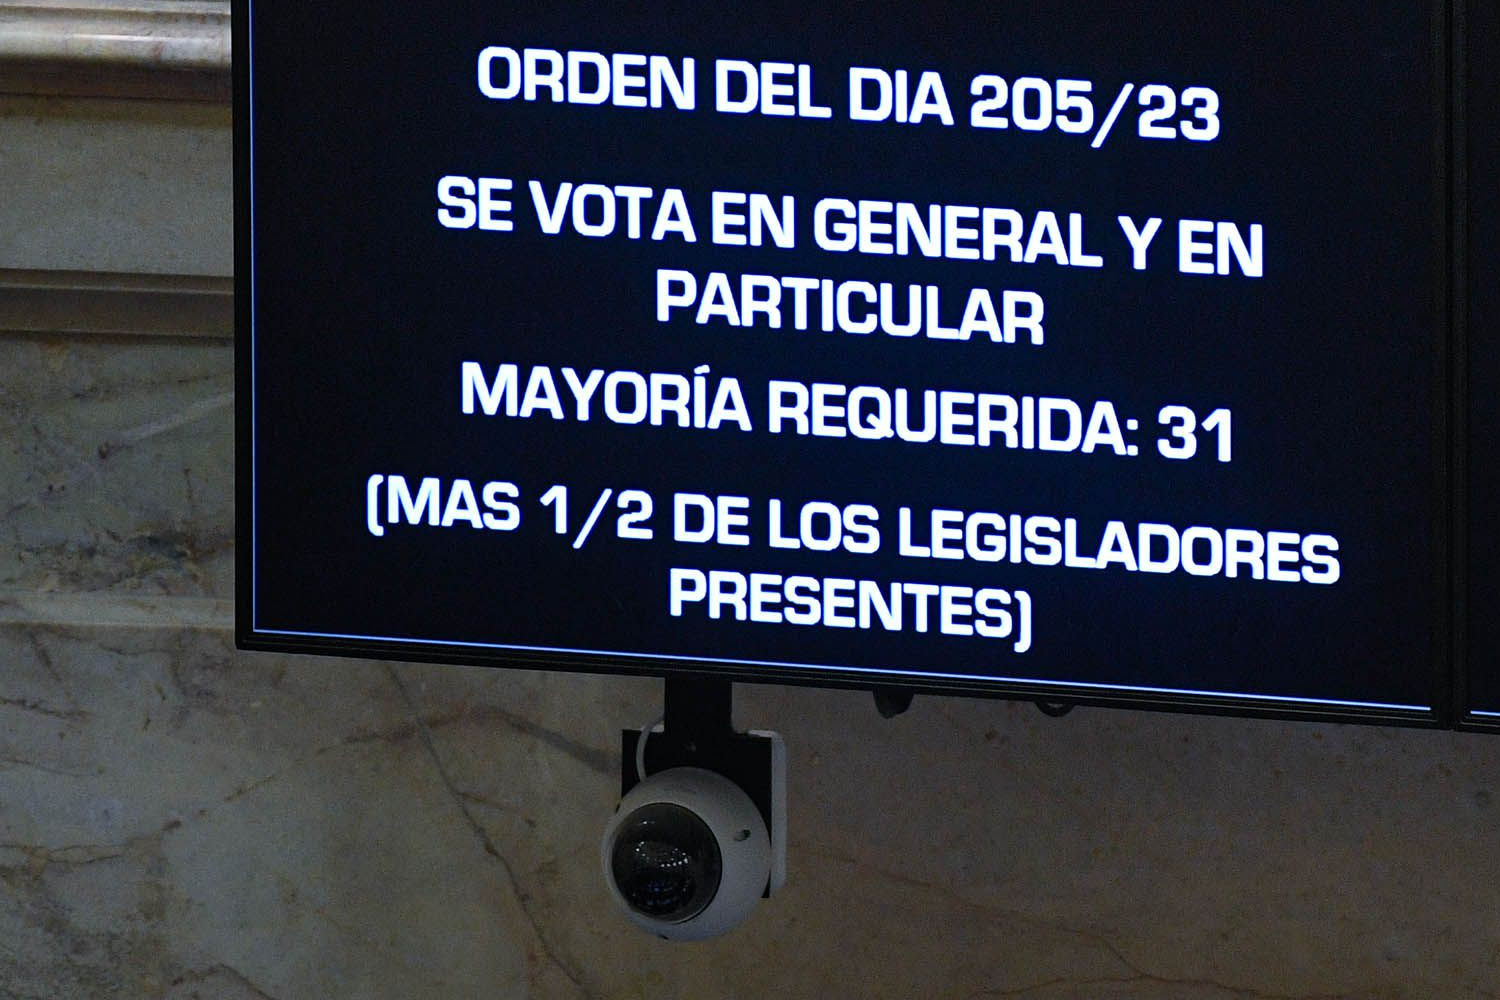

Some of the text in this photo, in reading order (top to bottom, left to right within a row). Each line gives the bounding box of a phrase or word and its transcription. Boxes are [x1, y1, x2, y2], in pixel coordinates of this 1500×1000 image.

[477, 46, 1220, 149] ORDEN DEL DIA 205/23
[437, 175, 1263, 278] SE VOTA EN GENERAL Y EN
[656, 268, 1045, 346] PARTICULAR
[461, 361, 1232, 463] MAYORÍA REQUERIDA: 31
[367, 474, 1341, 585] (MAS 1/2 DE LOS LEGISLADORES
[670, 567, 1032, 653] PRESENTES)
